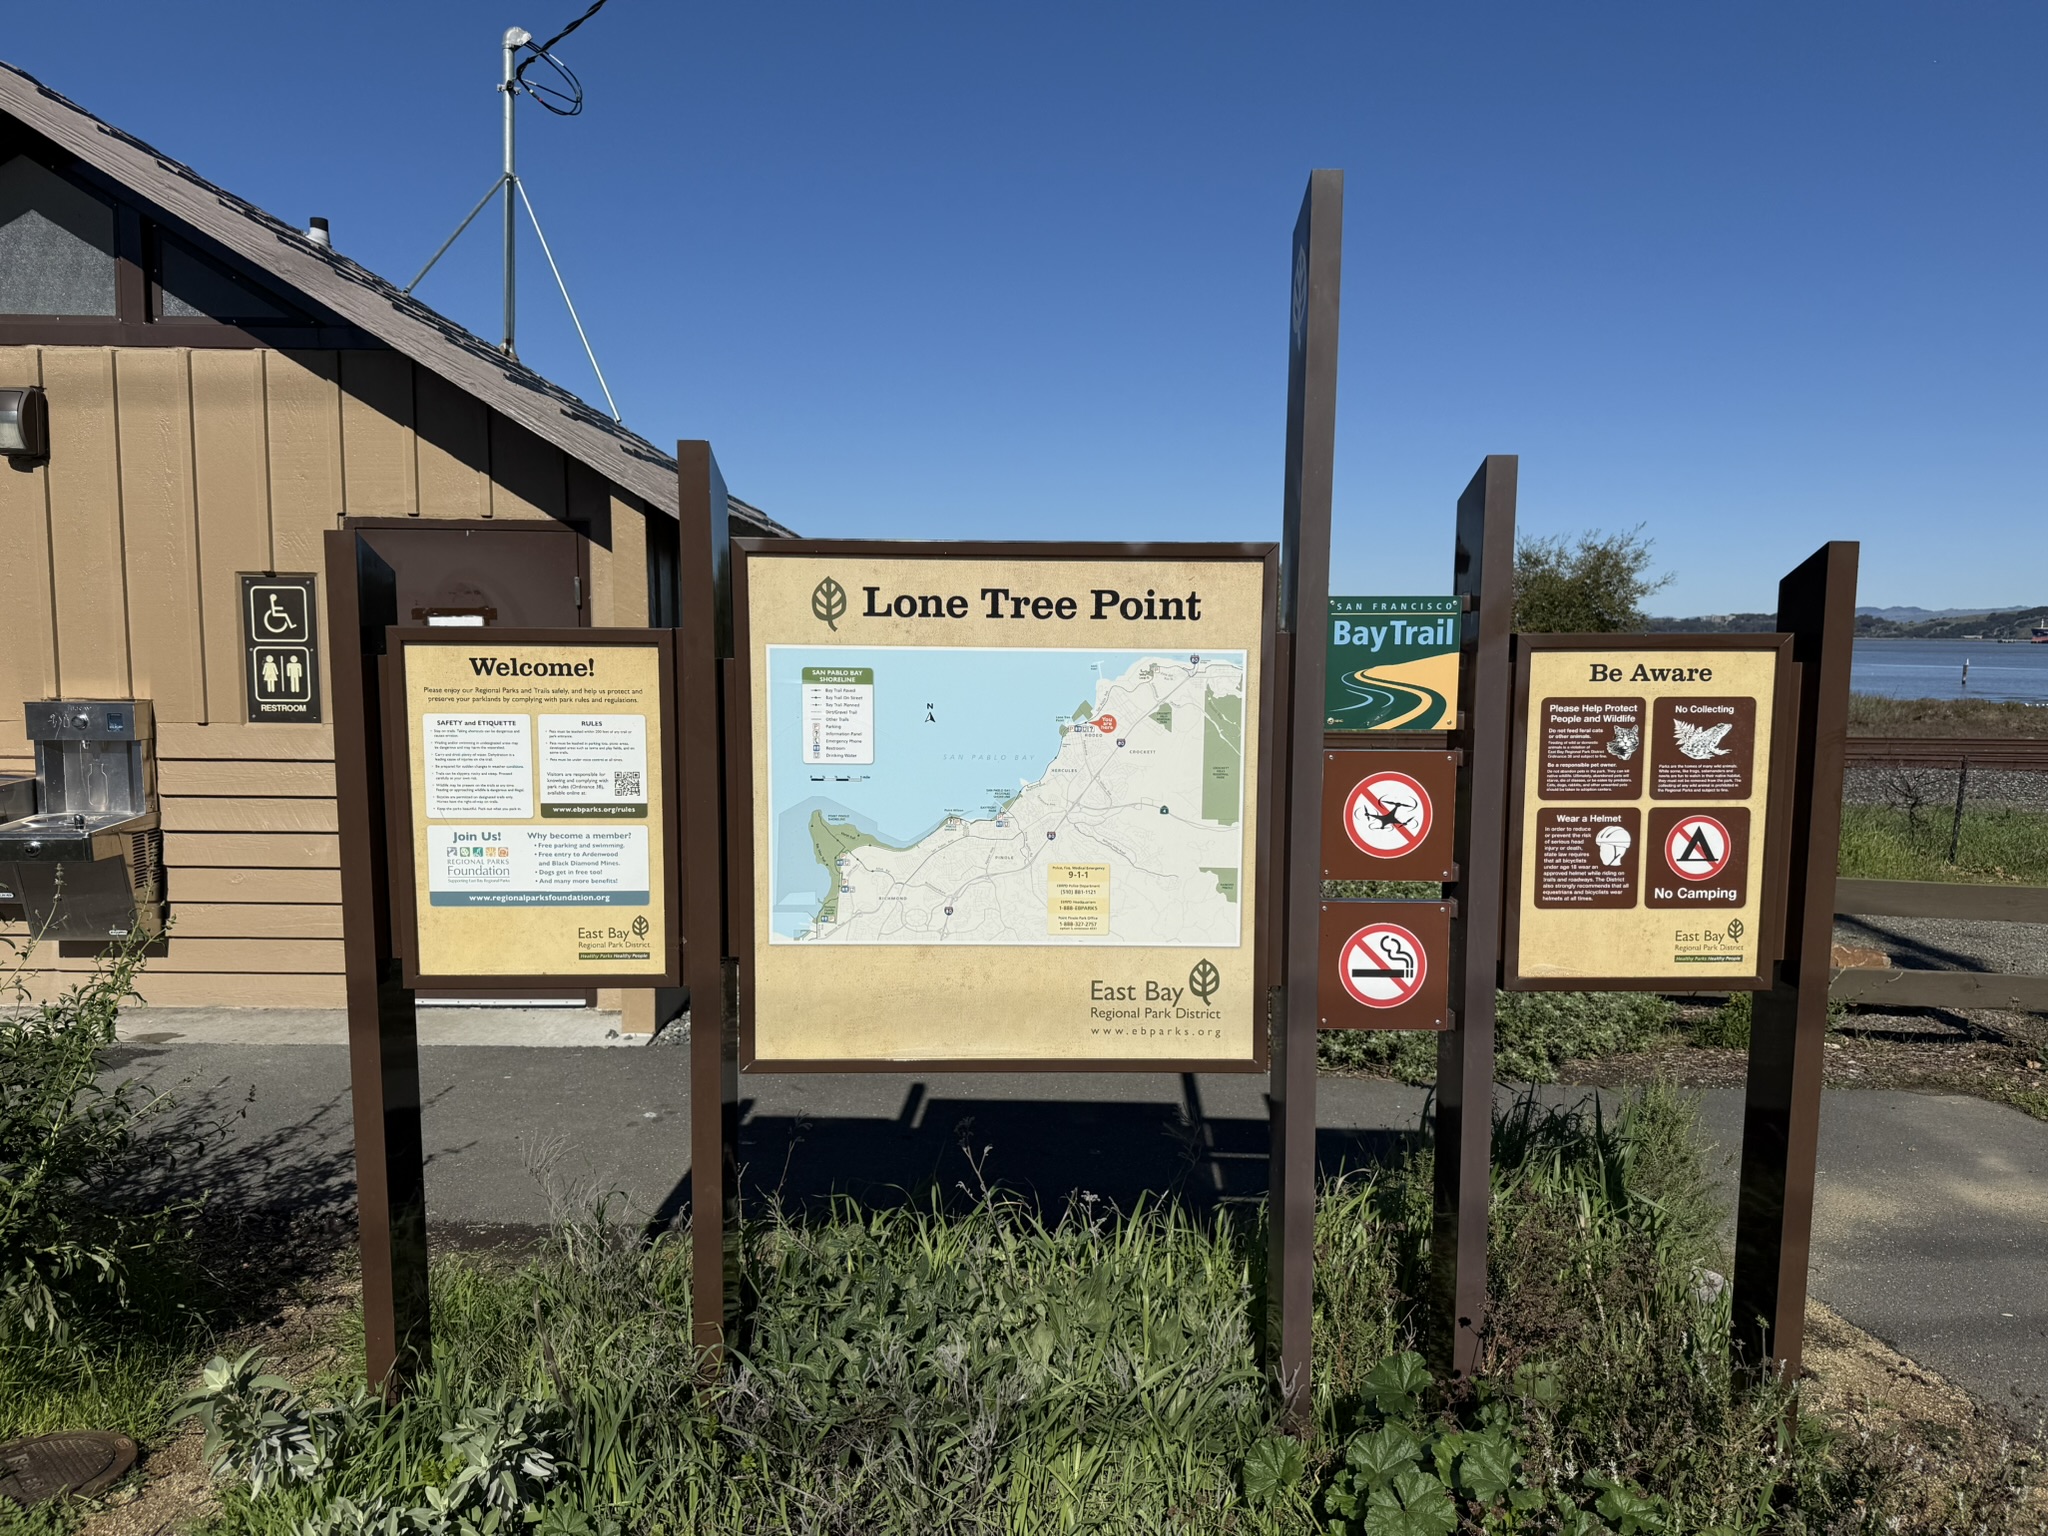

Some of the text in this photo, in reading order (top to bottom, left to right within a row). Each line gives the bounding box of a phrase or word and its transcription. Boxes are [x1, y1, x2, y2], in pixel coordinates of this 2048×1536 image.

[862, 586, 1202, 620] Lone Tree Point
[1337, 602, 1452, 610] SAN FRANCISCO
[469, 658, 594, 676] Welcome!
[1589, 664, 1712, 682] Be Aware
[1550, 704, 1638, 714] Please Help Protect
[1674, 704, 1734, 714] No Collecting
[1551, 714, 1636, 724] People and Wildlife
[1556, 814, 1580, 822] Wear
[1590, 814, 1622, 822] Helmet
[453, 832, 502, 844] Join Us!
[527, 832, 547, 841] Why
[448, 865, 510, 876] Foundation
[1068, 870, 1088, 878] 9-1-1
[468, 894, 610, 902] www.regionalparksfoundation.org
[1654, 887, 1737, 900] No Camping
[578, 926, 630, 942] East Bay
[1675, 930, 1725, 944] East Bay
[578, 941, 606, 950] Regional
[1674, 944, 1702, 952] Regional
[1091, 980, 1184, 1008] East Bay
[1090, 1007, 1221, 1021] Regional Park District
[1091, 1026, 1221, 1038] www.ebparks.org
